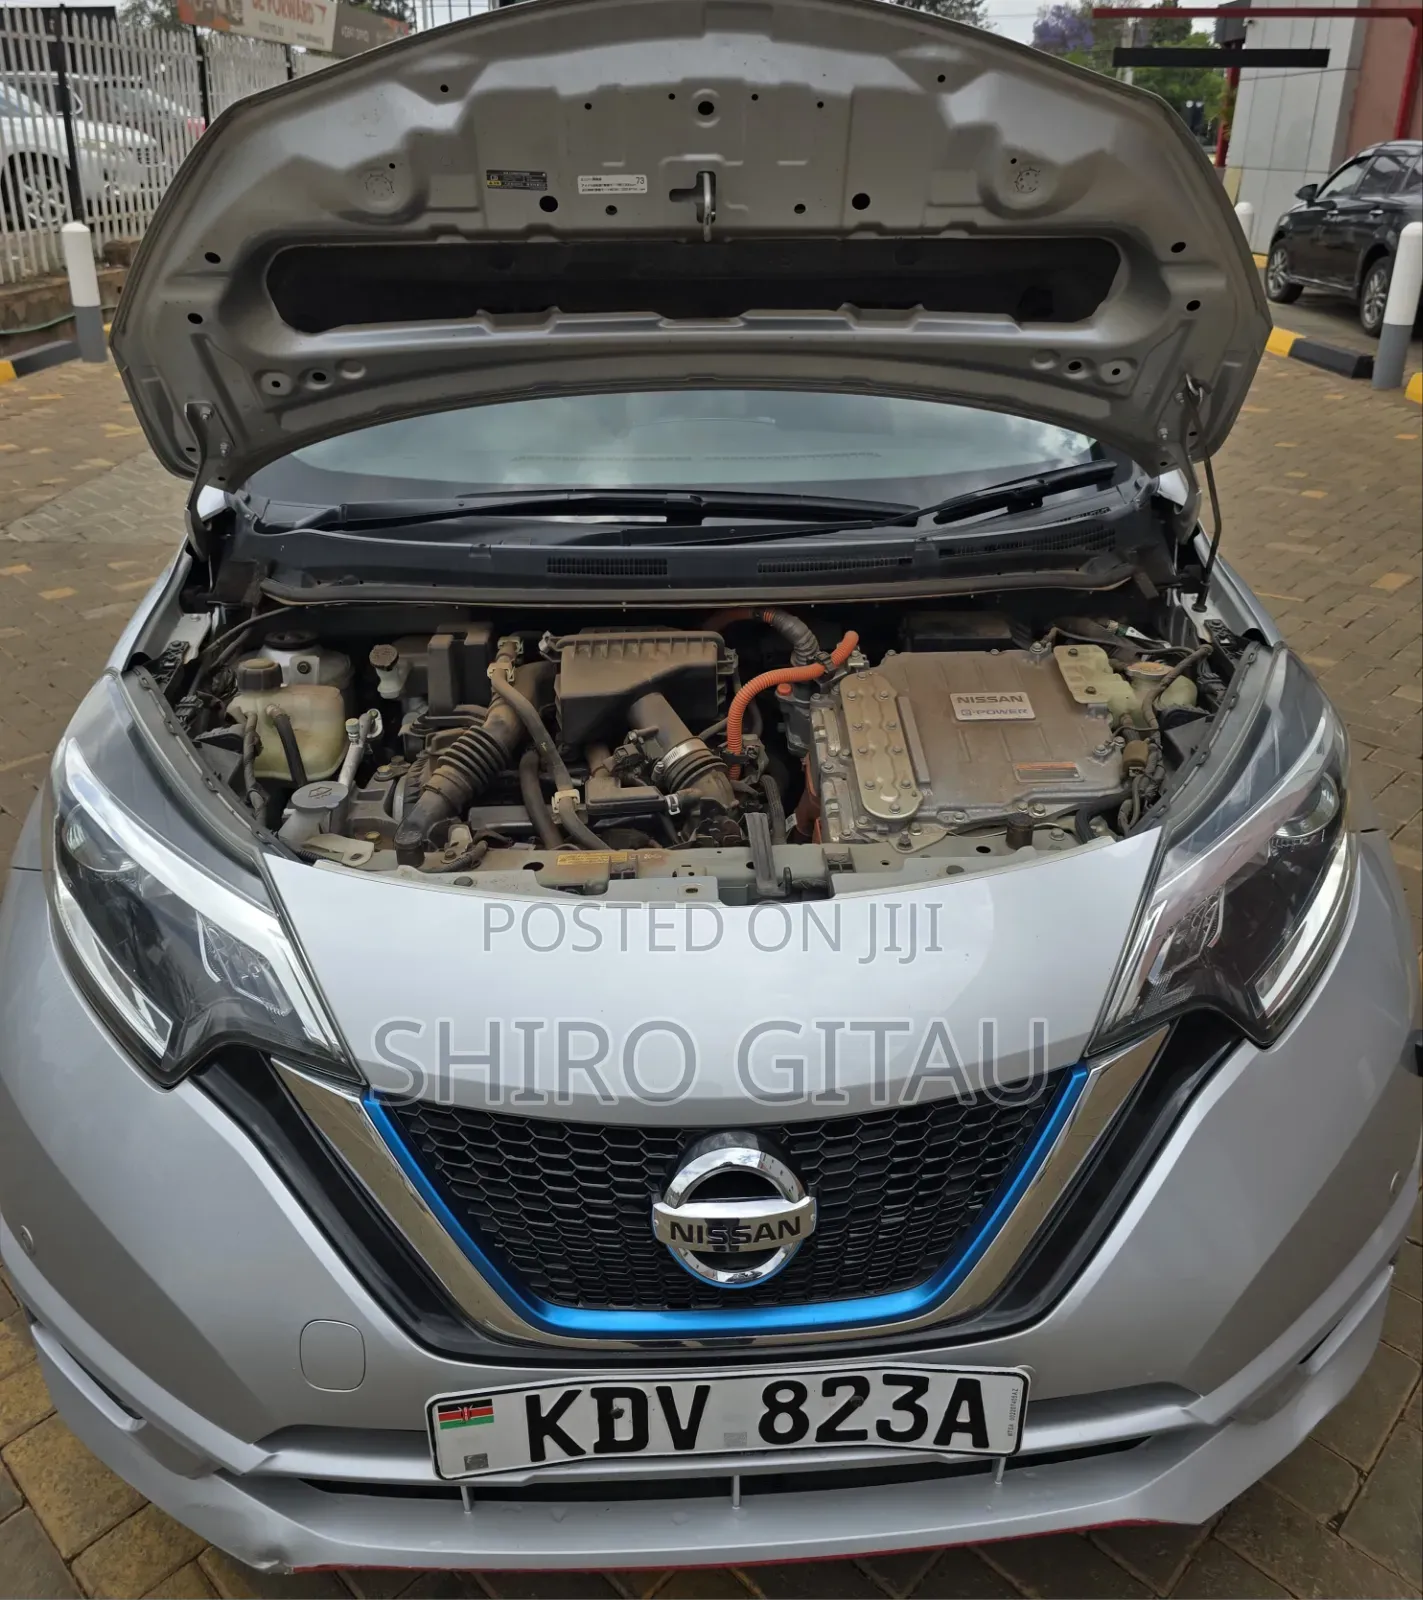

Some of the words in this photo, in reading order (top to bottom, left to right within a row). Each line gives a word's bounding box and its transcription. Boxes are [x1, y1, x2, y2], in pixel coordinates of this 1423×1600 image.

[635, 176, 645, 185] 73
[956, 695, 1024, 704] NISSAN
[669, 1216, 801, 1245] NISSAN
[525, 1384, 711, 1463] KDV
[757, 1373, 991, 1449] 823A
